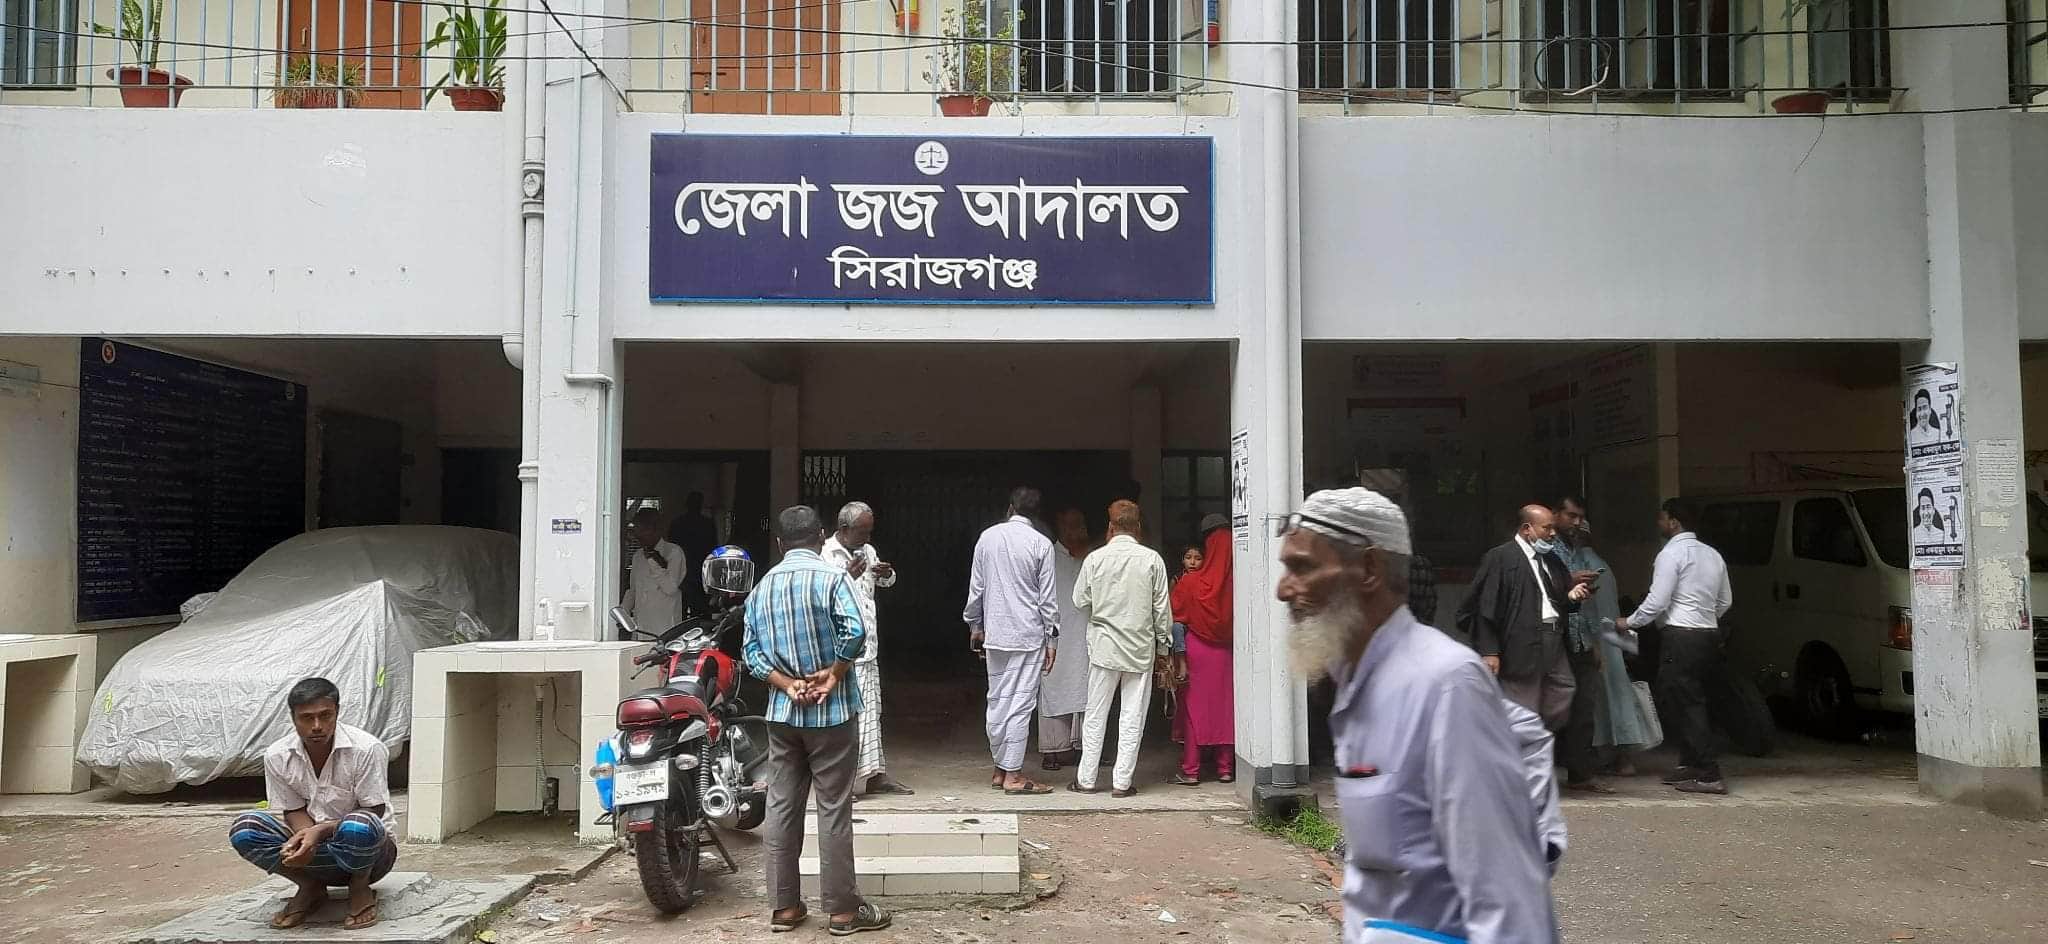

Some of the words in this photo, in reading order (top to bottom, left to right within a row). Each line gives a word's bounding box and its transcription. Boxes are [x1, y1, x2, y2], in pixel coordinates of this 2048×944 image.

[675, 176, 818, 238] জেলা
[831, 184, 945, 237] জজ
[957, 178, 1188, 240] আদালত
[827, 246, 1038, 290] সিরাজগঞ্জ
